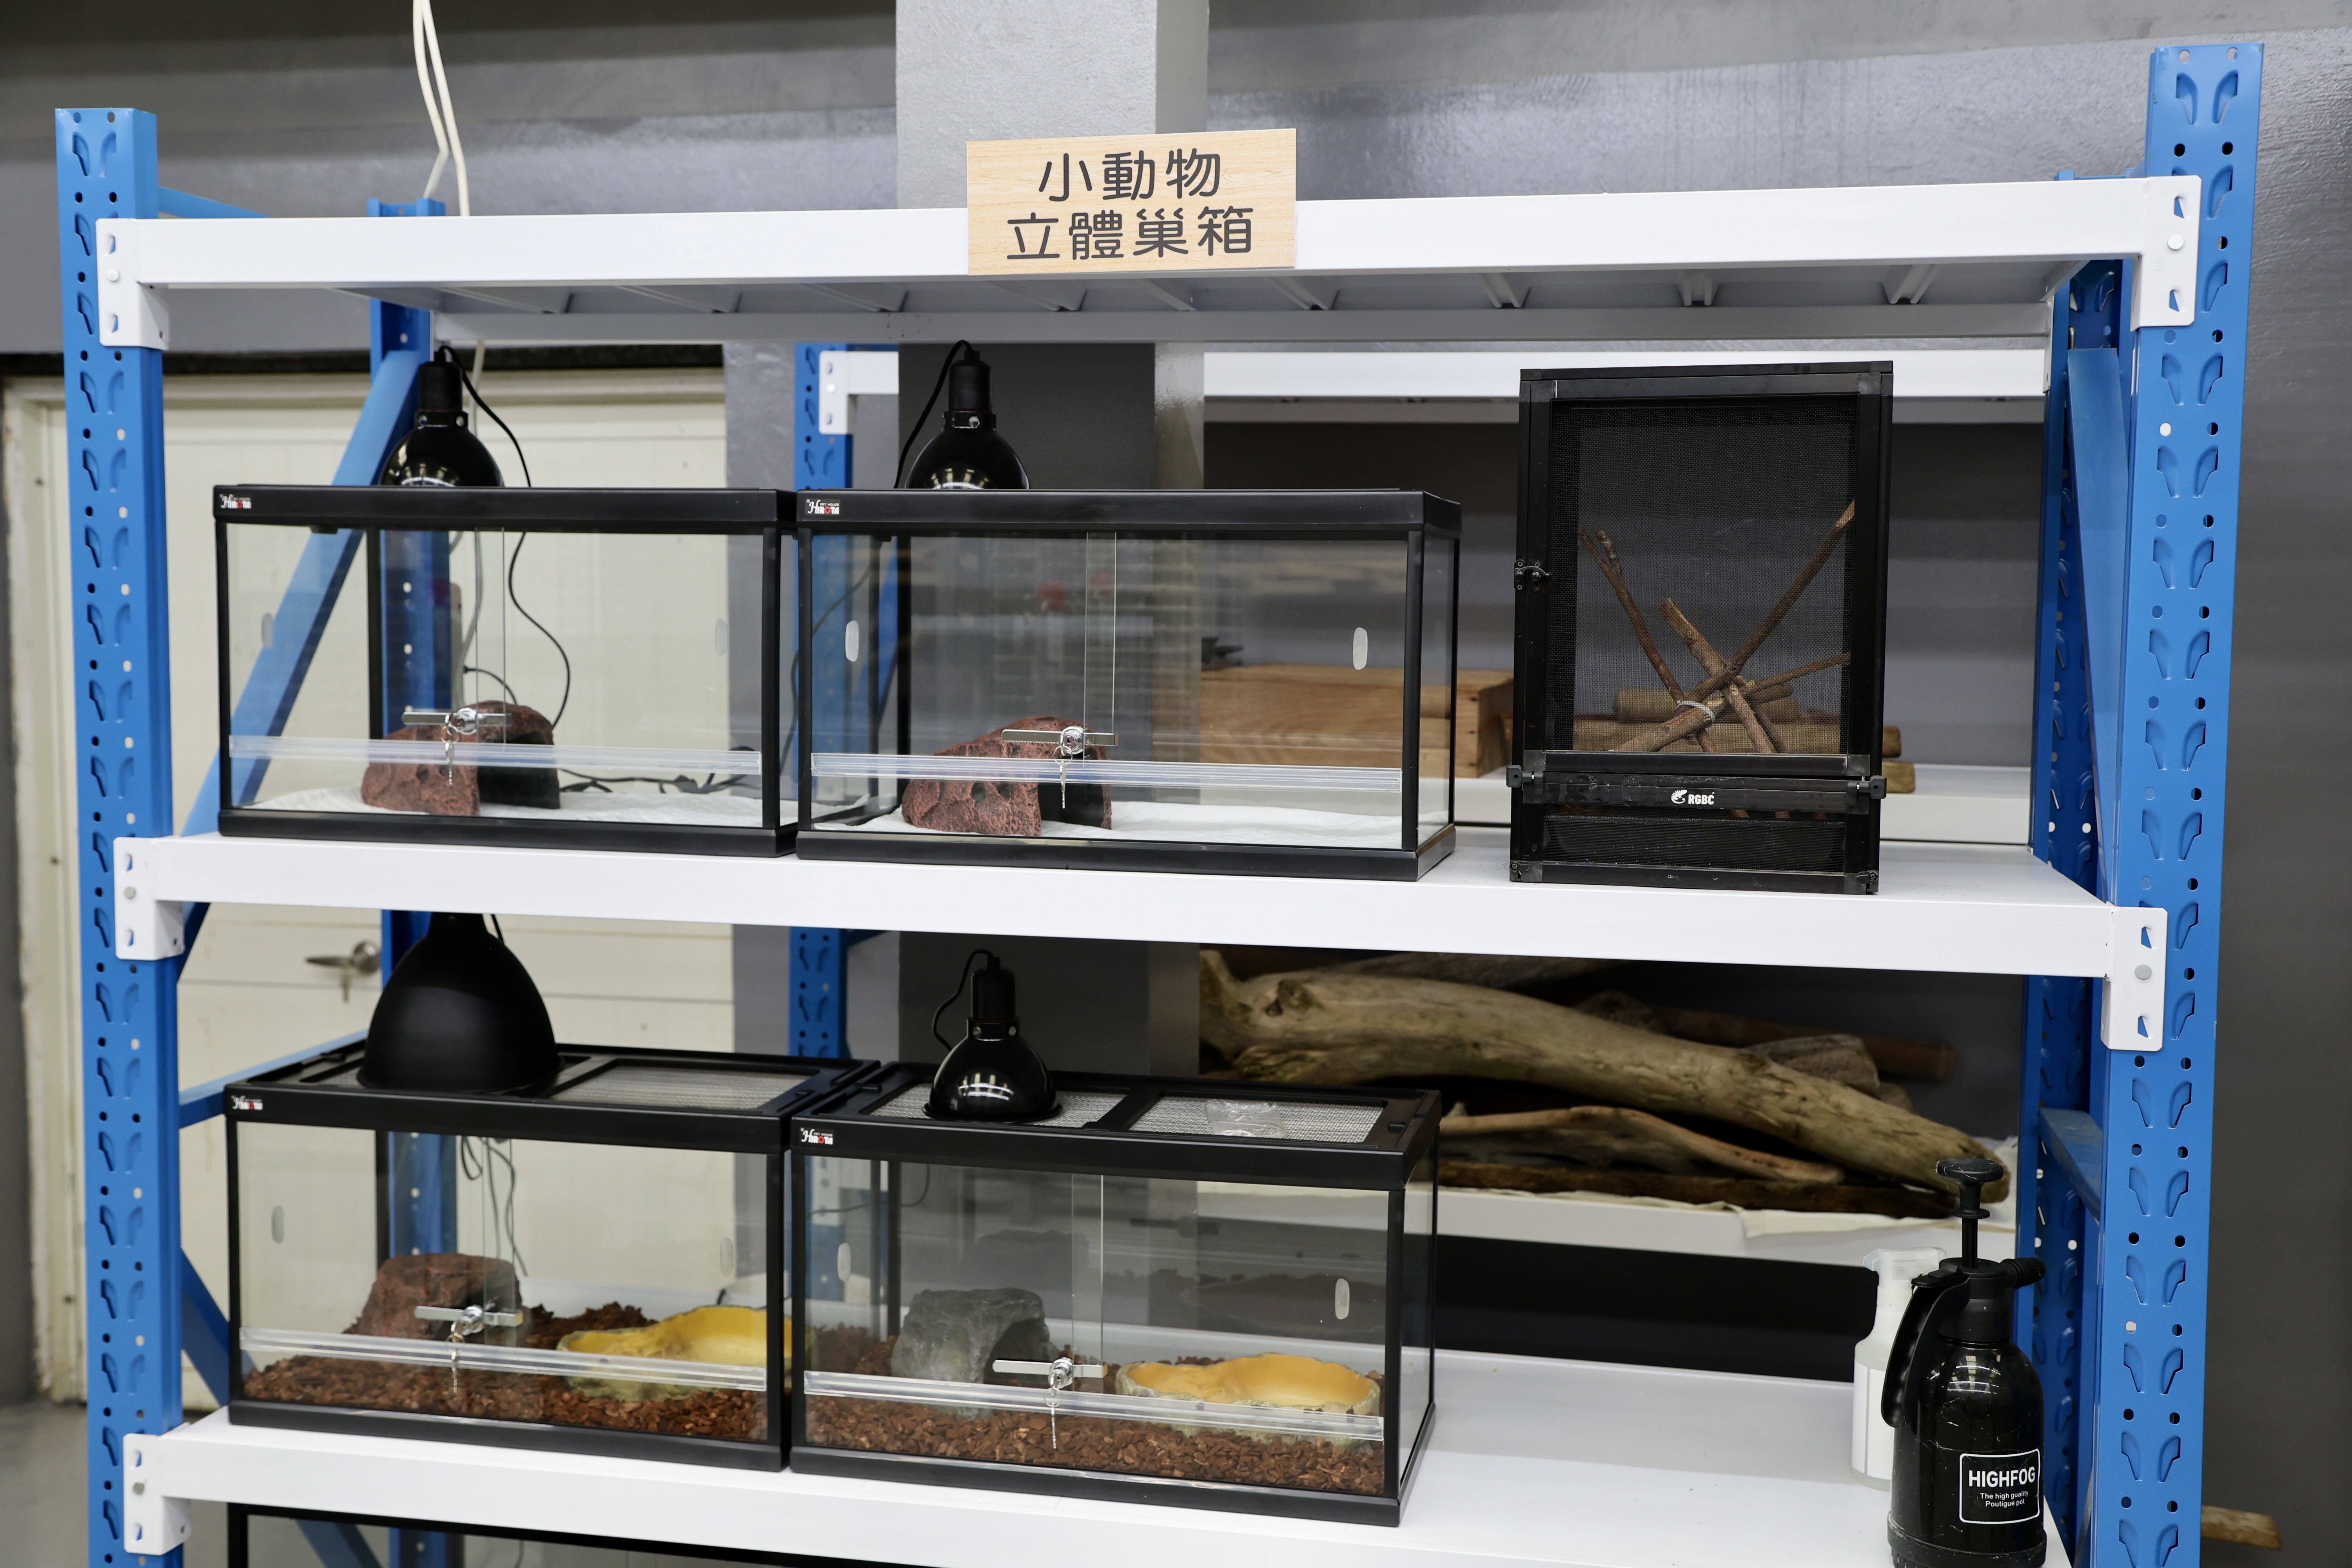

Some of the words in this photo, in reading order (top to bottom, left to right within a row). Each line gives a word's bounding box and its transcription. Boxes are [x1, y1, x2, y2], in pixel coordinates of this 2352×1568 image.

[1038, 148, 1221, 202] 小動物
[1007, 205, 1254, 260] 立體巢箱
[808, 499, 840, 515] HIROTA
[1688, 794, 1715, 805] RGBC
[801, 1129, 833, 1145] HIROTA
[1969, 1466, 2035, 1488] HIGHFOG
[2016, 1499, 2025, 1507] pot
